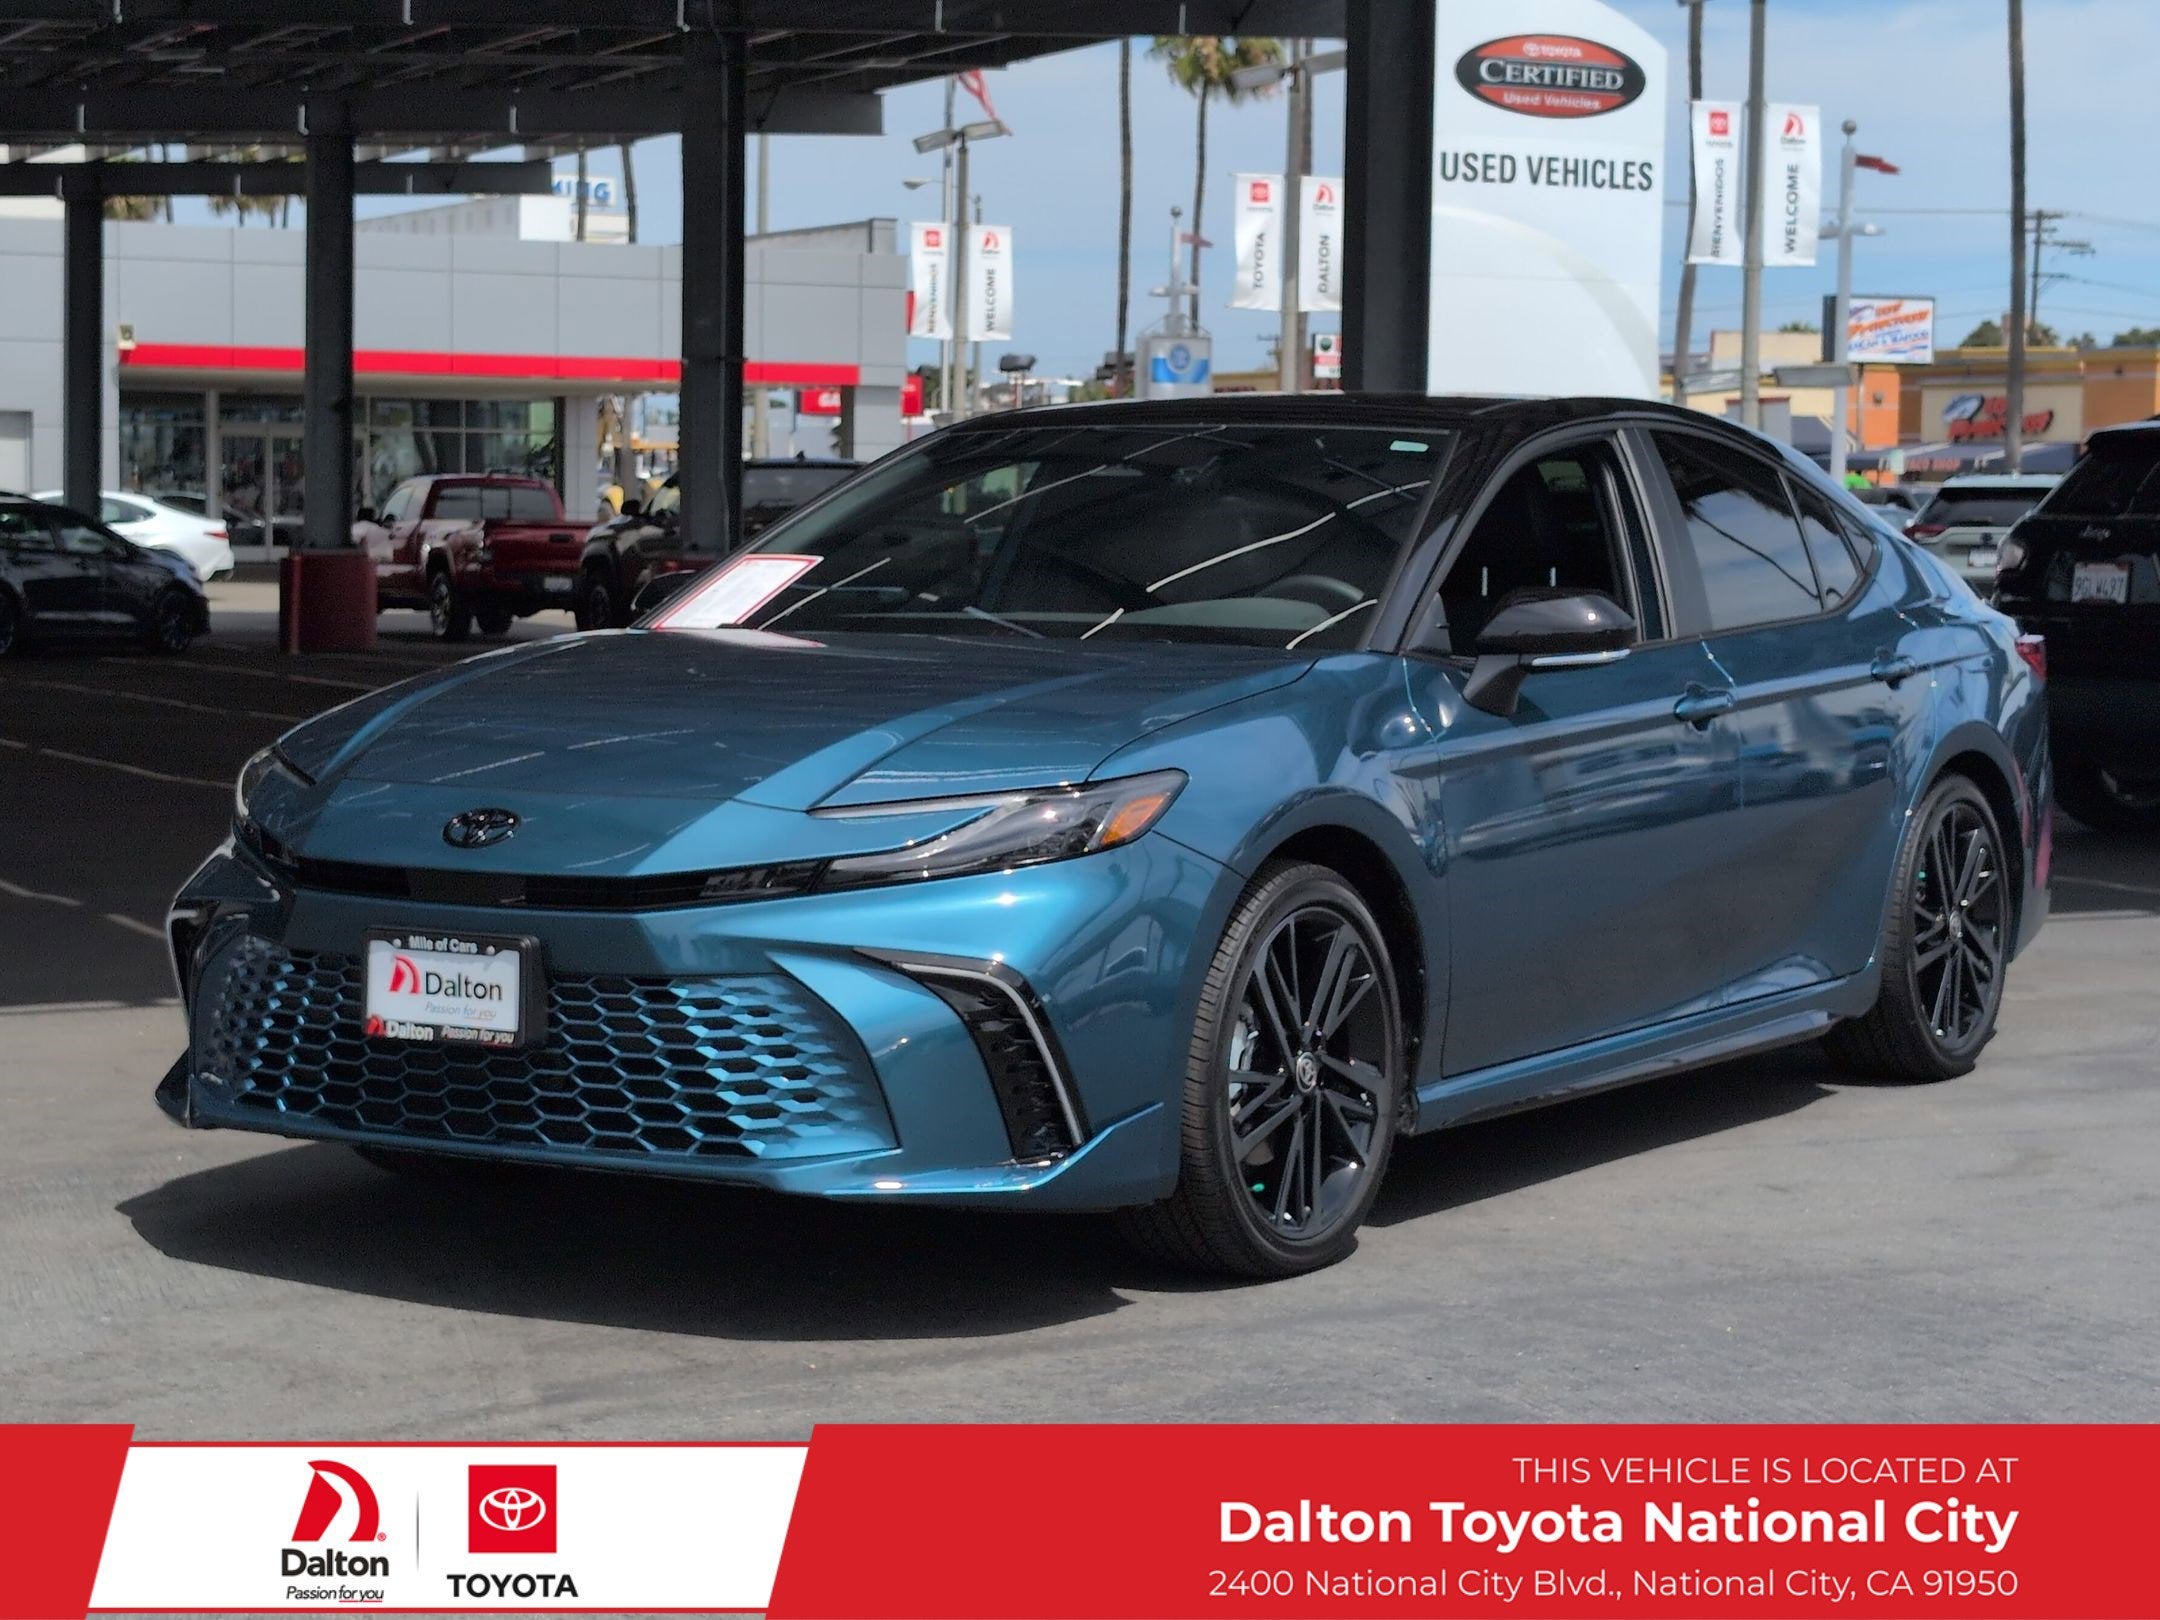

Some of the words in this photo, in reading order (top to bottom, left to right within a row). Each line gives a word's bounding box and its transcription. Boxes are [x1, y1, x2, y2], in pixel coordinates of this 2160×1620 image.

[1540, 43, 1582, 58] TOYOTA
[1479, 58, 1624, 90] CERTIFIED
[1503, 92, 1541, 105] Used
[1543, 94, 1601, 110] Vehicles
[1441, 152, 1516, 184] USED
[1527, 155, 1654, 191] VEHICLES
[1784, 164, 1799, 254] WELCOME
[1252, 232, 1265, 289] TOYOTA
[1317, 235, 1331, 293] DALTON
[985, 268, 997, 332] WELCOME
[408, 935, 434, 951] Mile
[435, 938, 448, 951] of
[449, 939, 478, 953] Cars
[425, 971, 503, 1000] Dalton
[425, 1002, 461, 1016] Passion
[463, 1005, 476, 1017] for
[477, 1008, 497, 1020] you
[386, 1020, 434, 1041] Dalton
[440, 1025, 478, 1040] Passion
[479, 1028, 494, 1042] for
[494, 1031, 515, 1045] you
